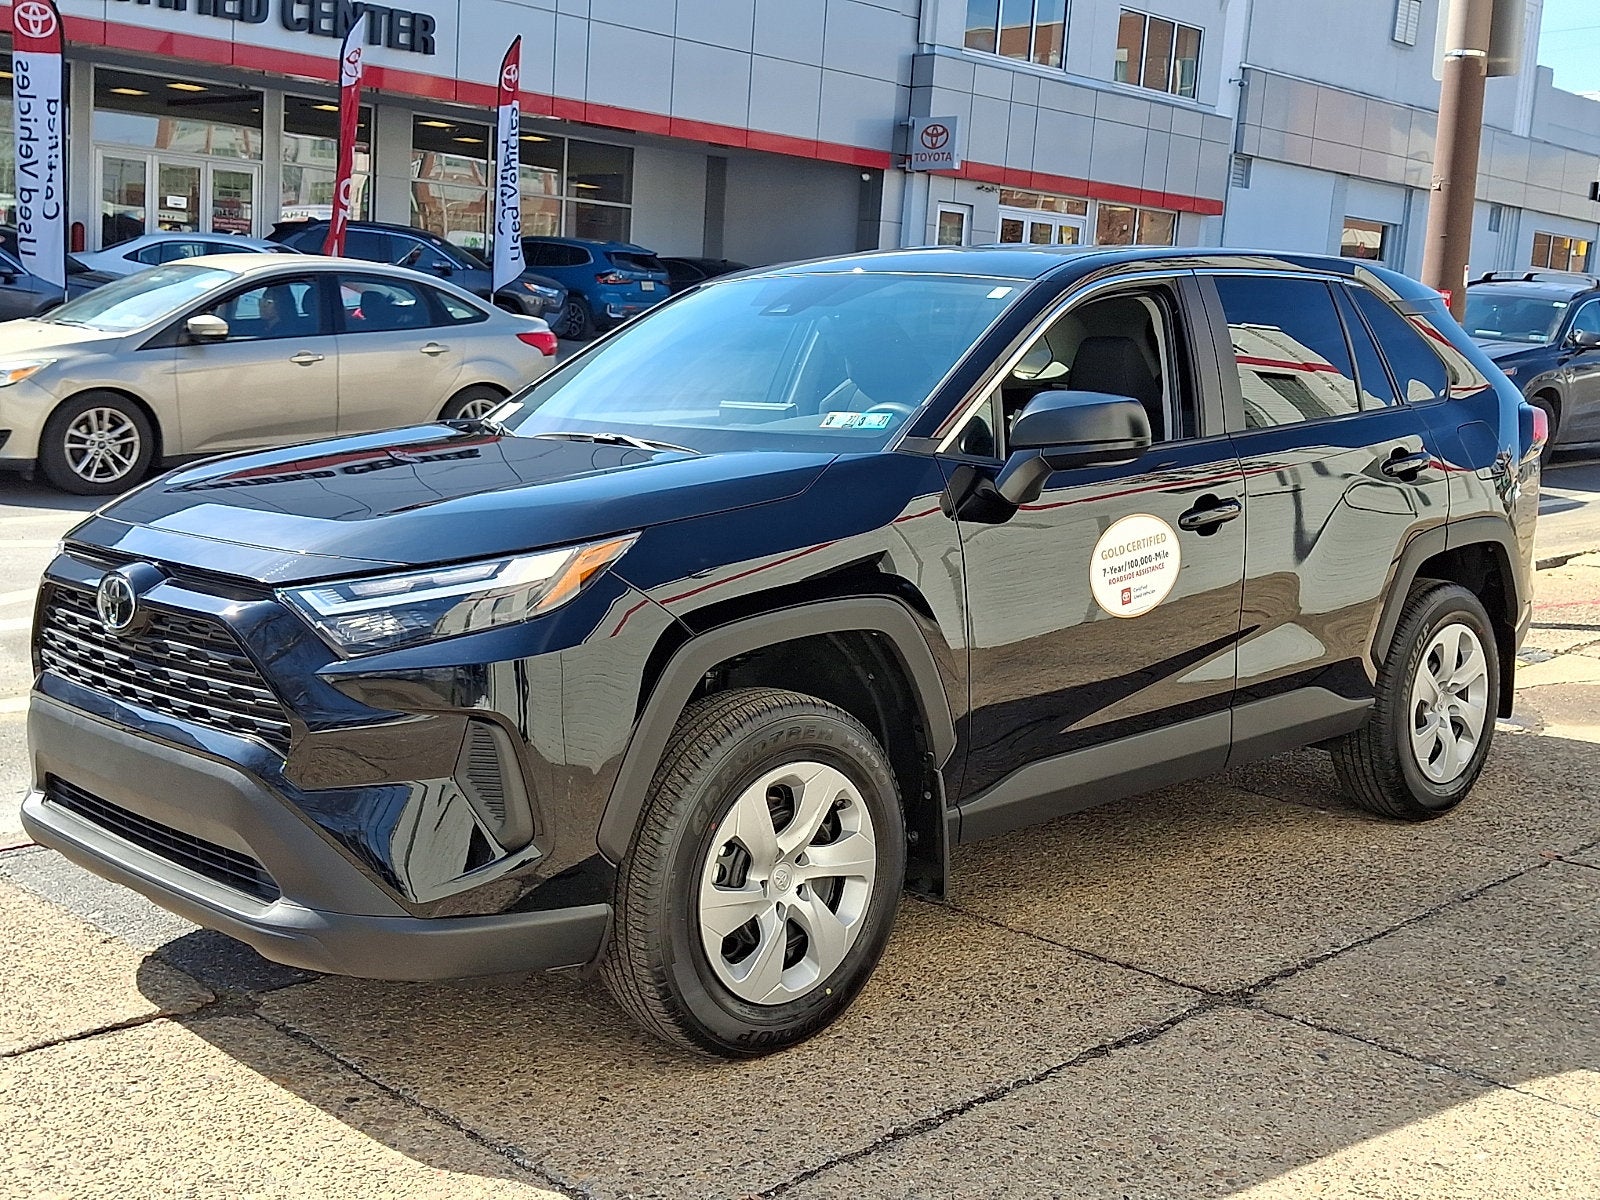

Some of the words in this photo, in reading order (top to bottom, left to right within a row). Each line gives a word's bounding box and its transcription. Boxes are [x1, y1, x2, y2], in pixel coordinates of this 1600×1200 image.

[281, 0, 436, 56] CENTER
[914, 151, 953, 162] TOYOTA
[1101, 544, 1126, 561] GOLD
[1126, 532, 1167, 553] CERTIFIED
[1102, 549, 1169, 578] 7-Year/100,000-Mile
[1108, 571, 1135, 586] ROADSIDE
[1135, 562, 1165, 577] ASSISTANCE
[1401, 622, 1430, 701] DUNLOP
